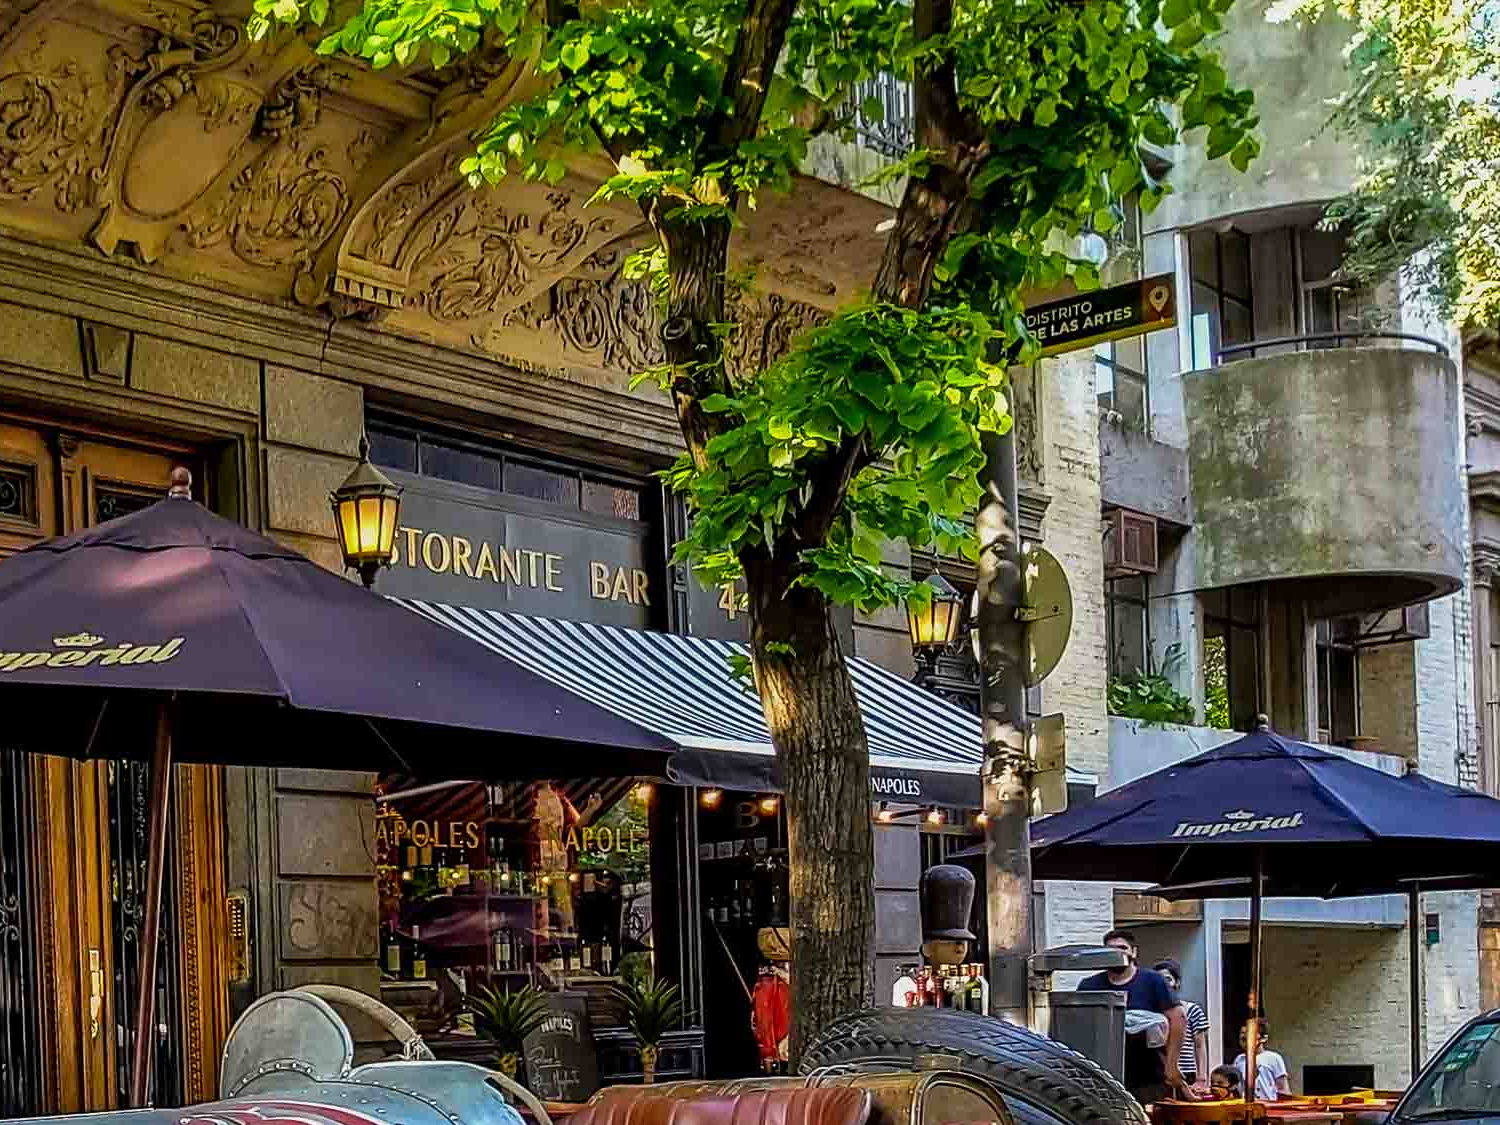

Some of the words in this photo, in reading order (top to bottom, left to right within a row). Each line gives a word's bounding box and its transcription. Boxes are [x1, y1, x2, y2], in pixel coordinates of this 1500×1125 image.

[1026, 301, 1093, 328] DISTRITO
[1051, 319, 1079, 337] LAS
[1083, 306, 1133, 329] ARTES
[590, 559, 651, 607] BAR
[871, 776, 921, 796] NAPOLES
[1170, 812, 1305, 838] Imperial
